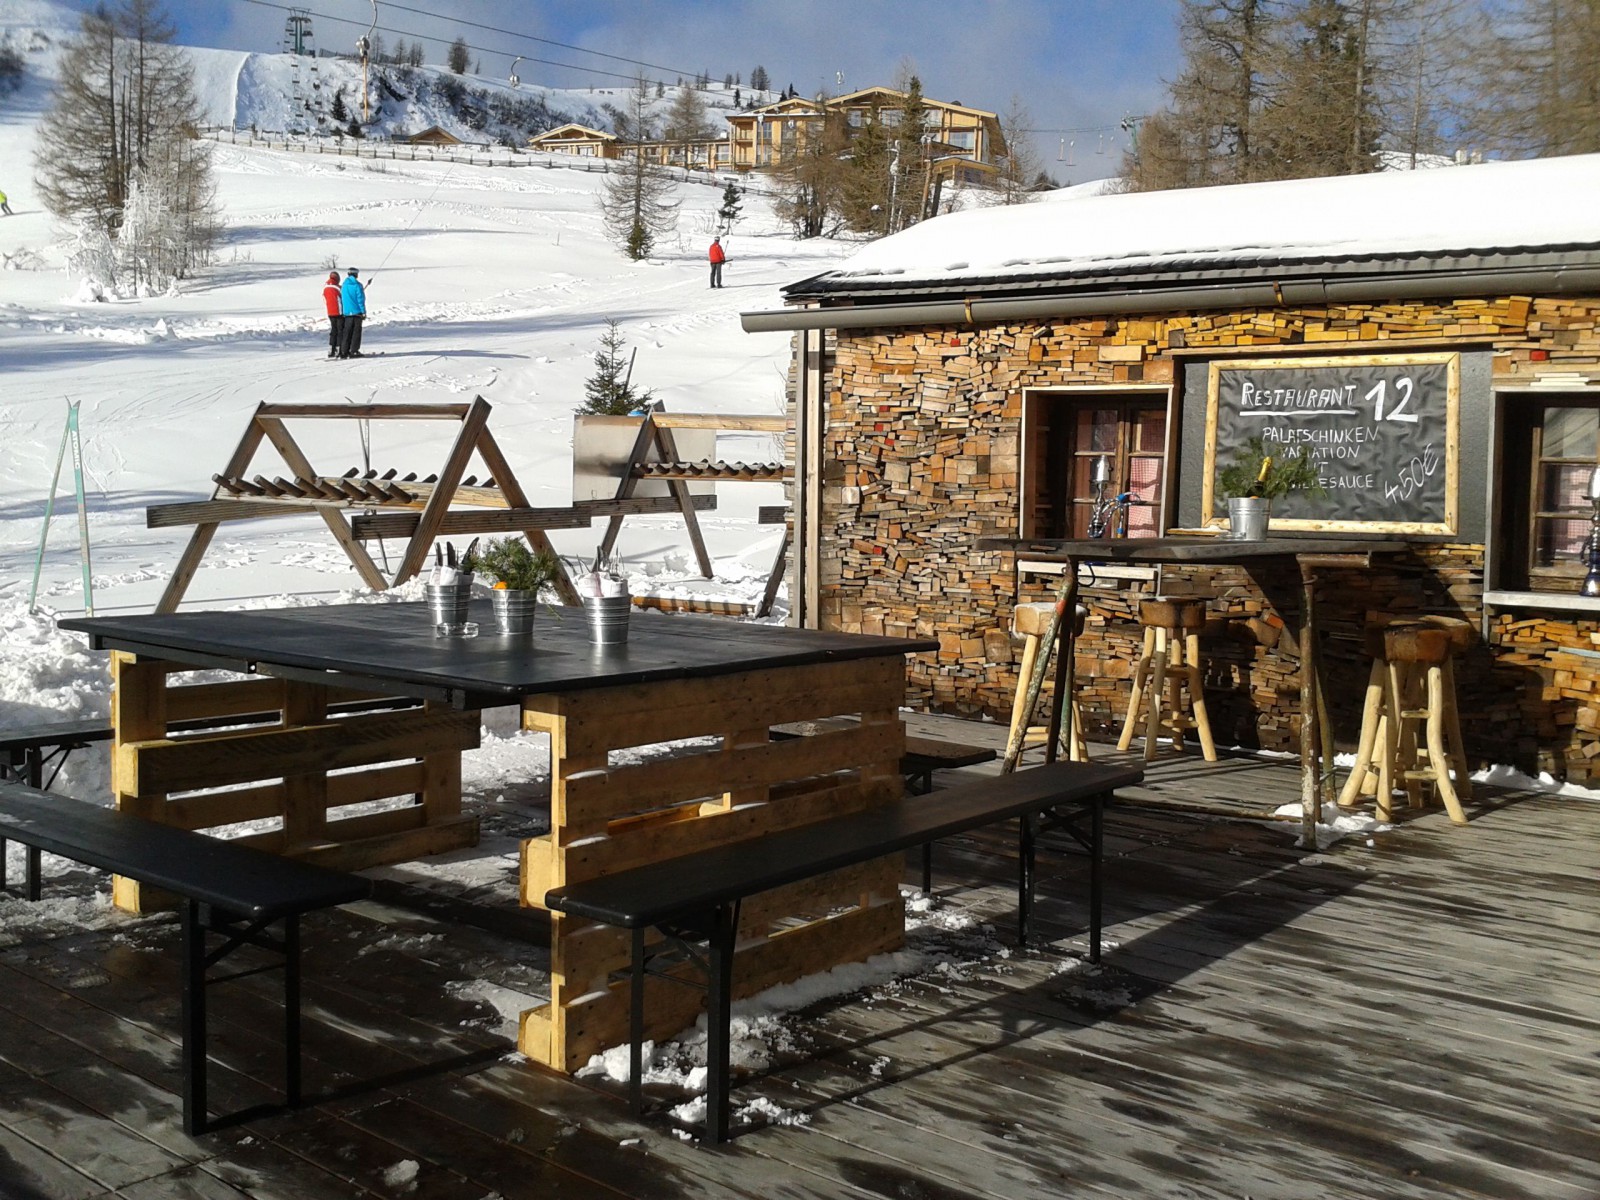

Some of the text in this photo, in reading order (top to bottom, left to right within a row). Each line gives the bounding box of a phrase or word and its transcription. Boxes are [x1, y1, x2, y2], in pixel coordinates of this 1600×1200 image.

[1241, 377, 1418, 422] RESTAURANT 12
[71, 430, 80, 470] ATOMIC
